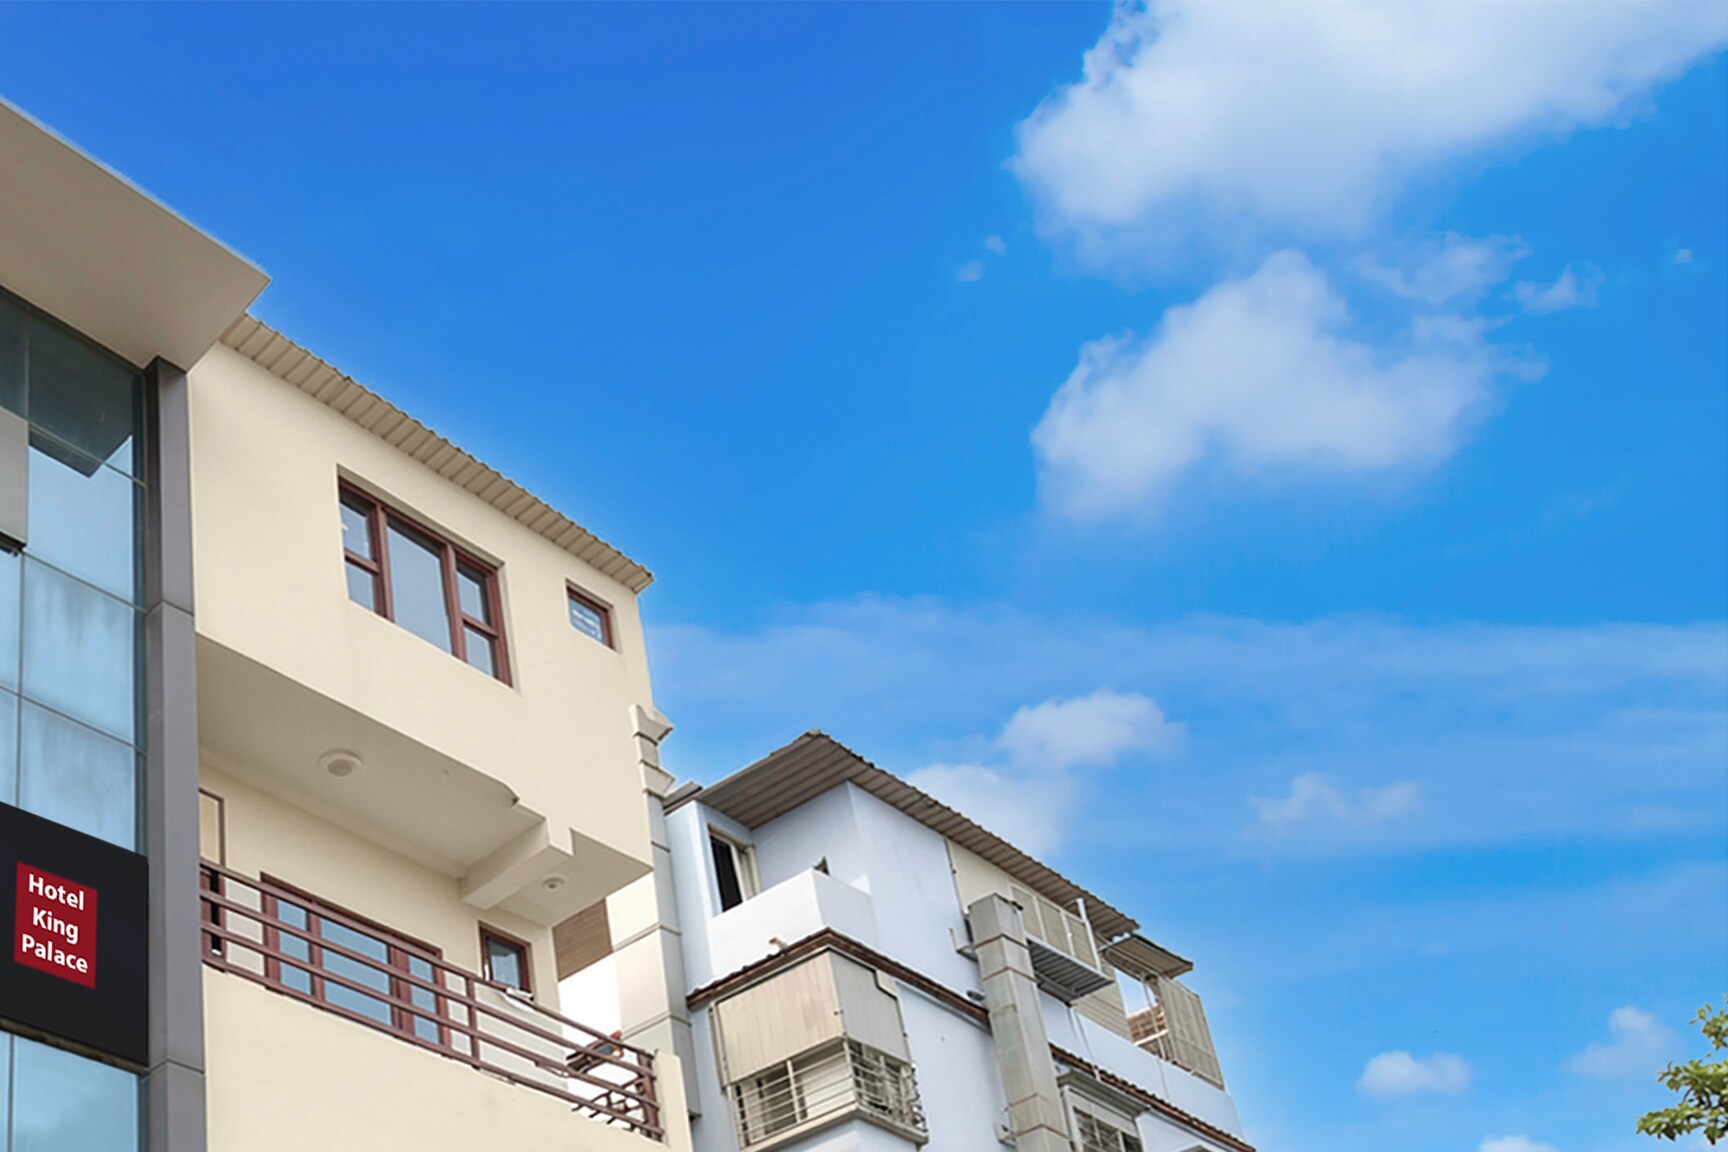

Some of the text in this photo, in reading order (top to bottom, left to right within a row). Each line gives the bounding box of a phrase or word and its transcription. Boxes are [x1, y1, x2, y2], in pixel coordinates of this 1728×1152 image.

[27, 873, 85, 911] Hotel
[31, 906, 80, 945] King
[21, 933, 89, 974] Palace
